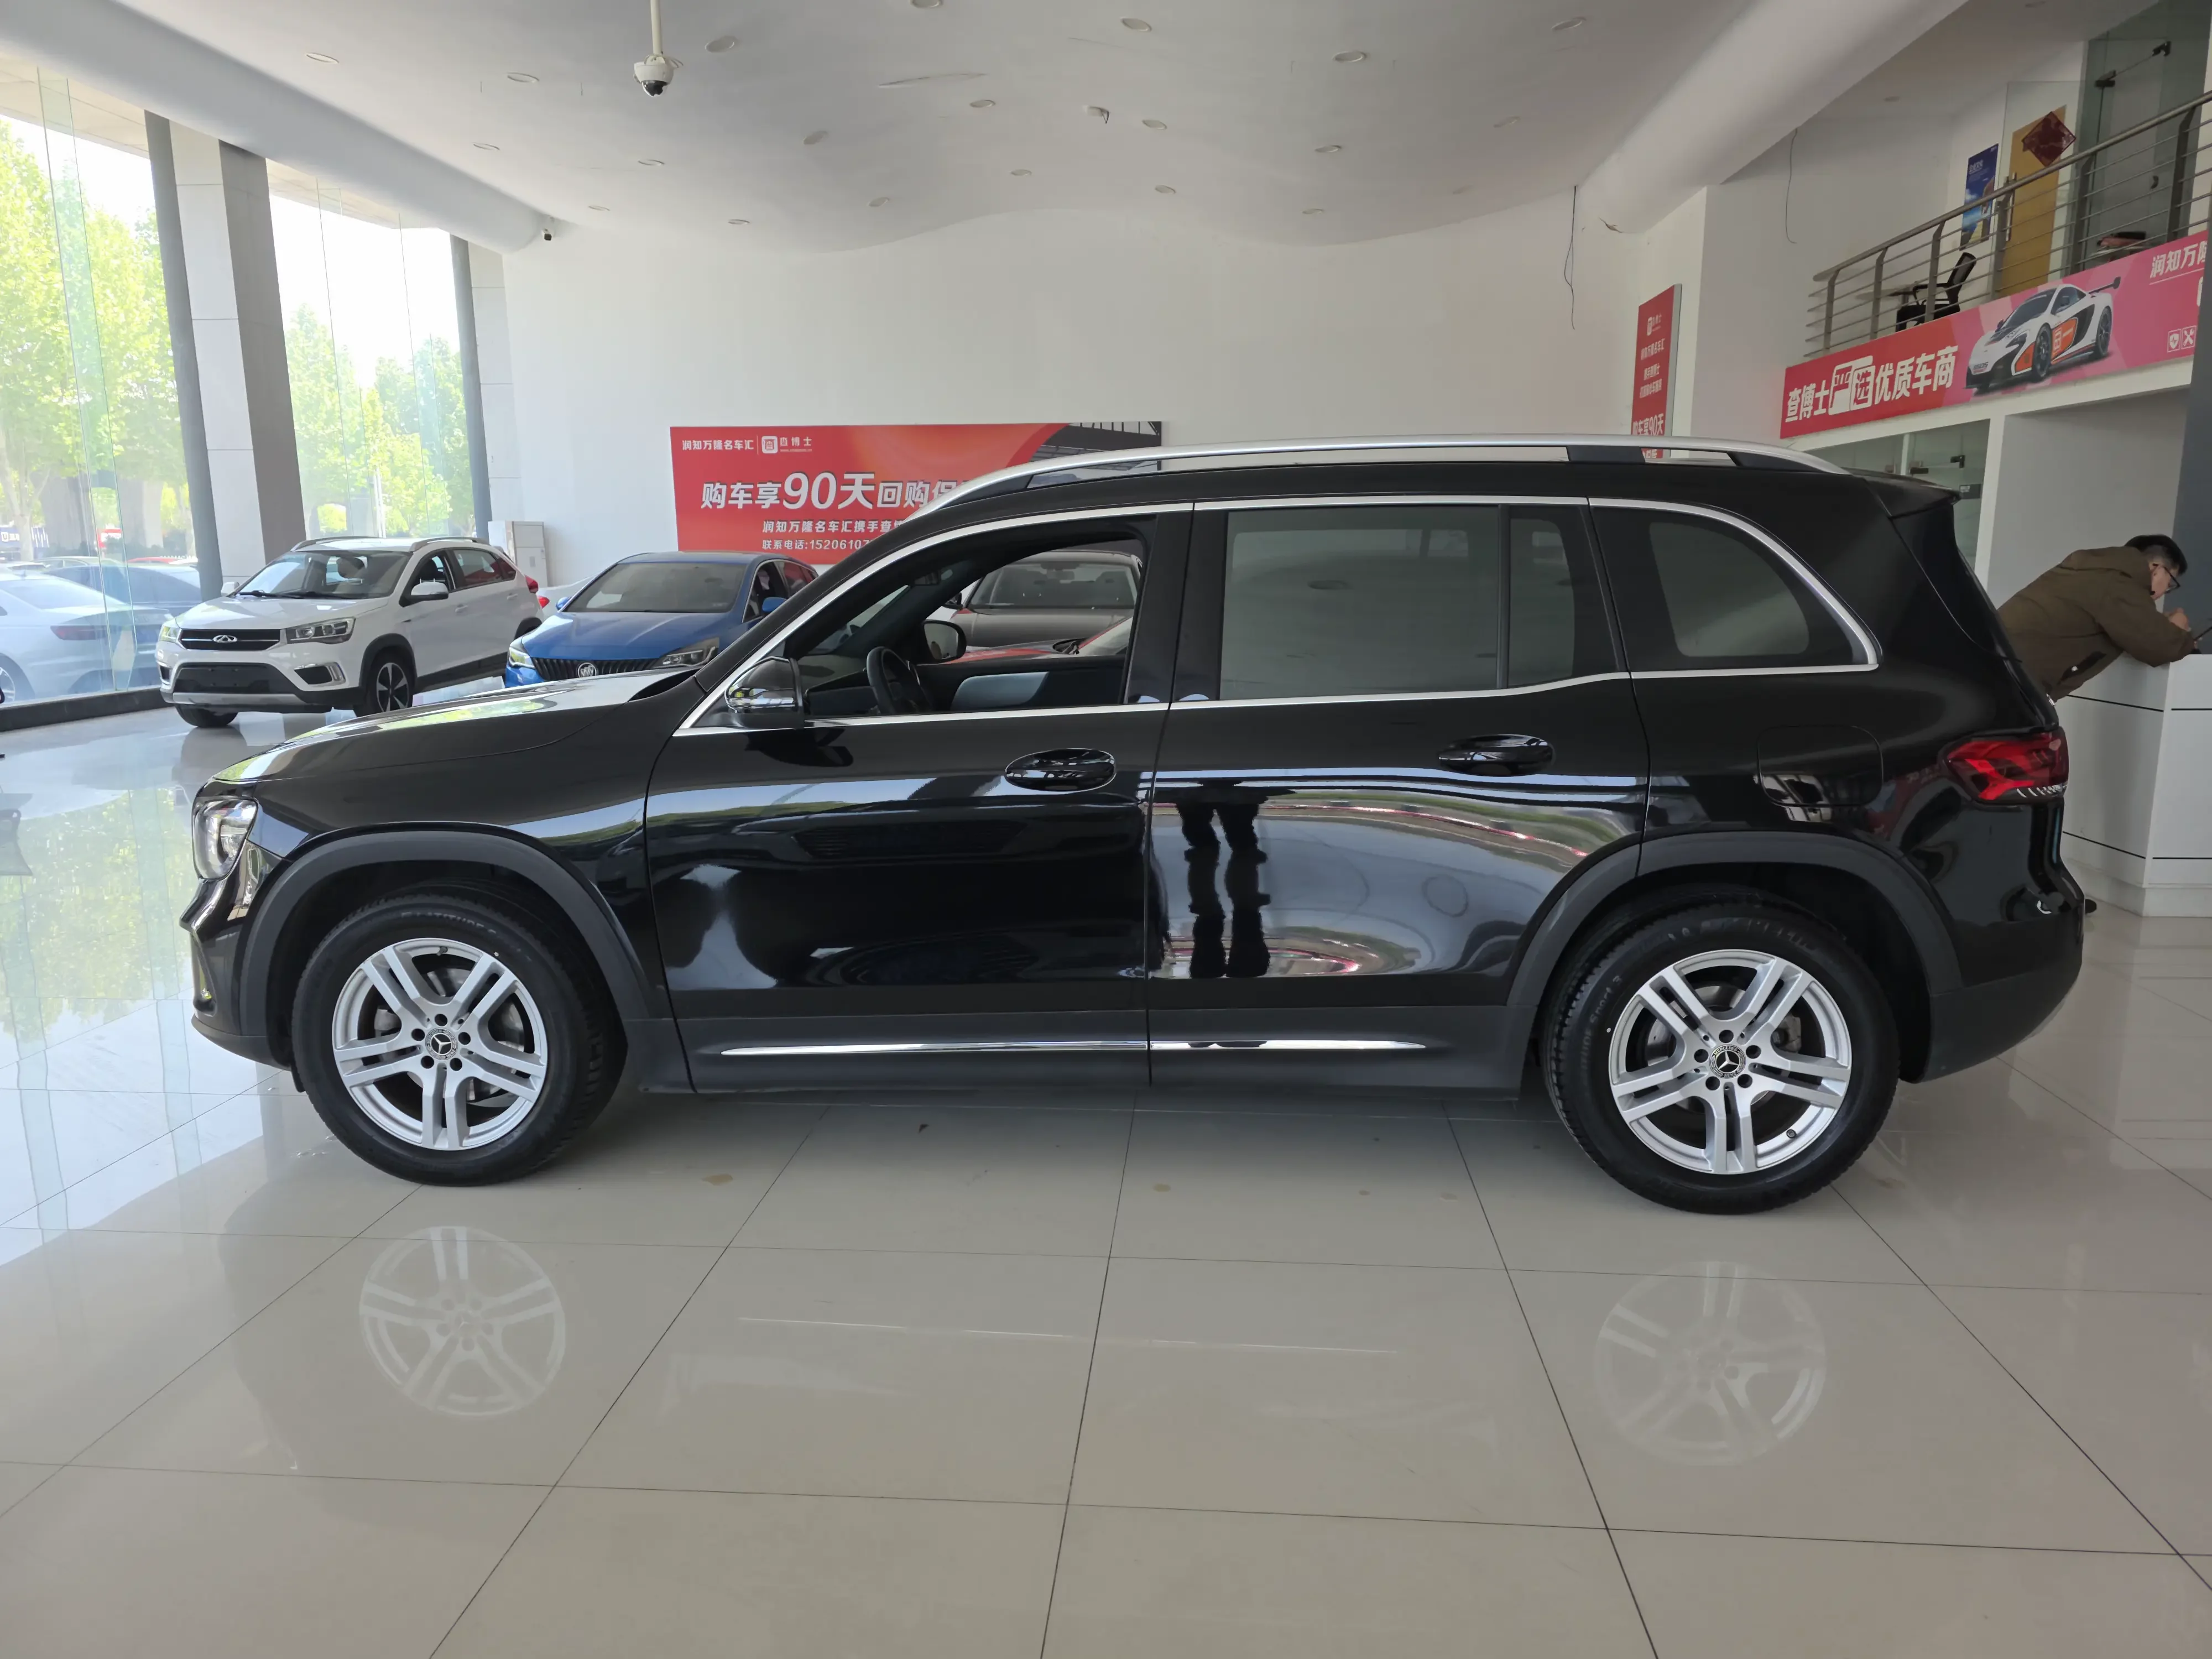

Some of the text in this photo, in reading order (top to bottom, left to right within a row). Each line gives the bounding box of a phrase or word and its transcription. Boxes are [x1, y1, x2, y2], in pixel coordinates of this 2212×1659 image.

[682, 439, 754, 451] 润知万隆名车汇
[780, 436, 812, 447] 查博士
[763, 539, 874, 550] 联系电话:15206107
